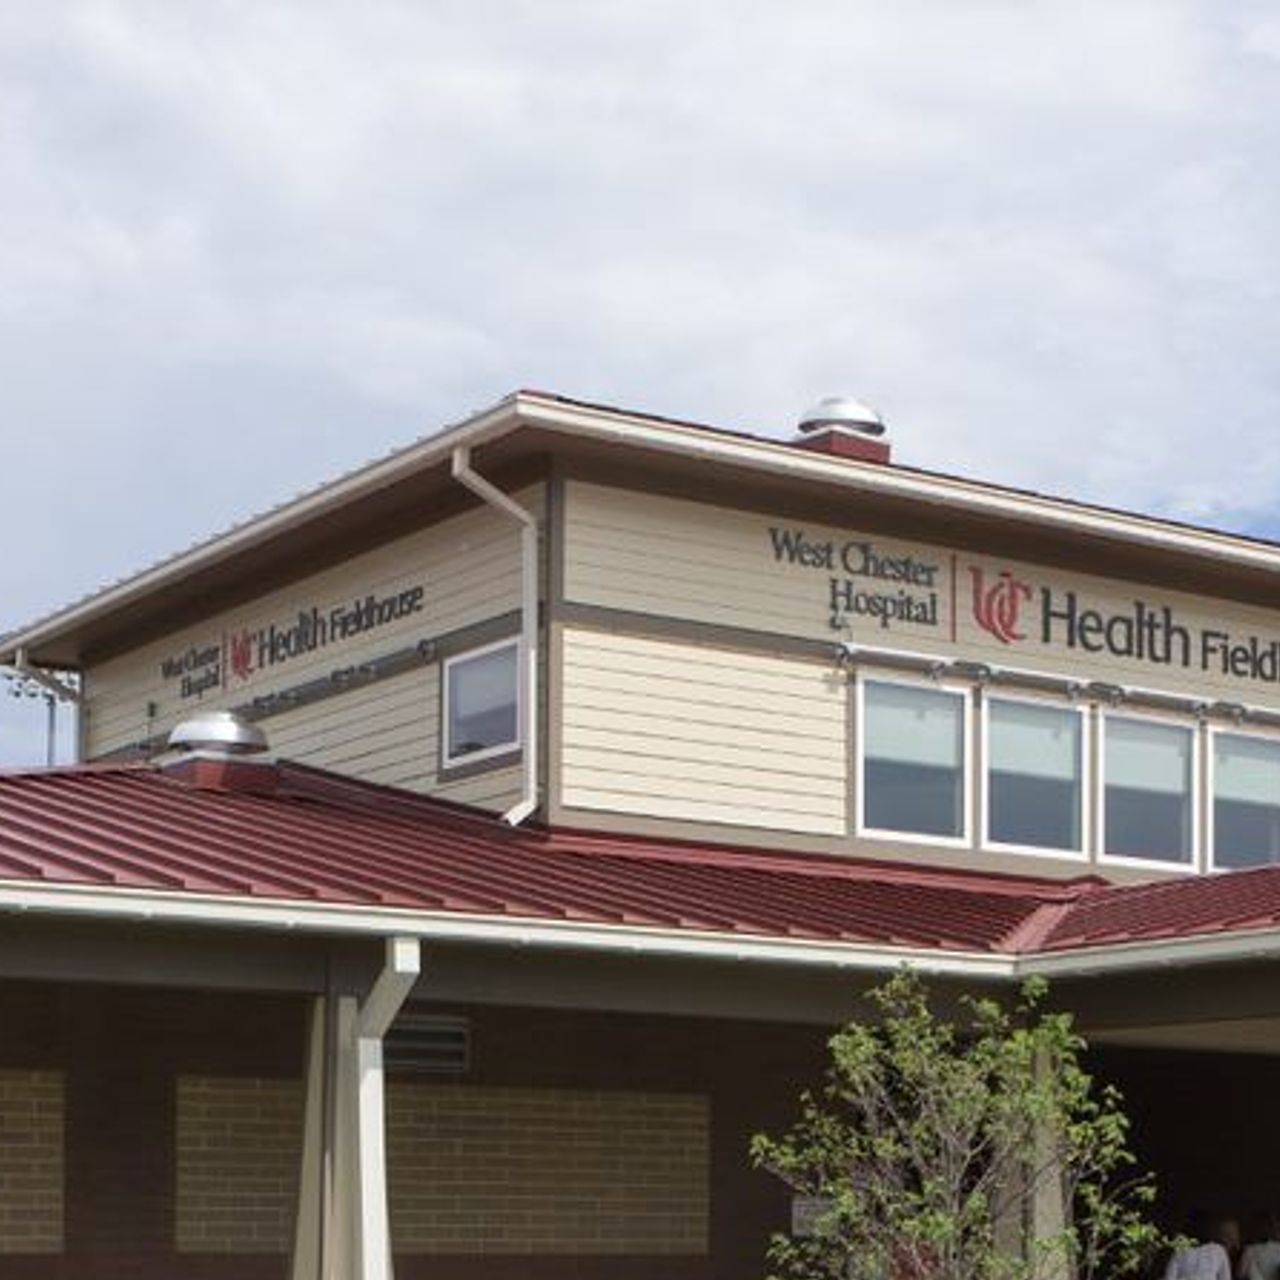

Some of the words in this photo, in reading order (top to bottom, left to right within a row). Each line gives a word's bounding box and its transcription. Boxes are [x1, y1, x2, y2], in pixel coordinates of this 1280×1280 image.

[768, 527, 834, 570] West
[841, 541, 938, 587] Chester
[258, 607, 326, 669] Health
[329, 585, 424, 642] Fieldhouse
[830, 577, 938, 628] Hospital
[1040, 587, 1190, 668] Health
